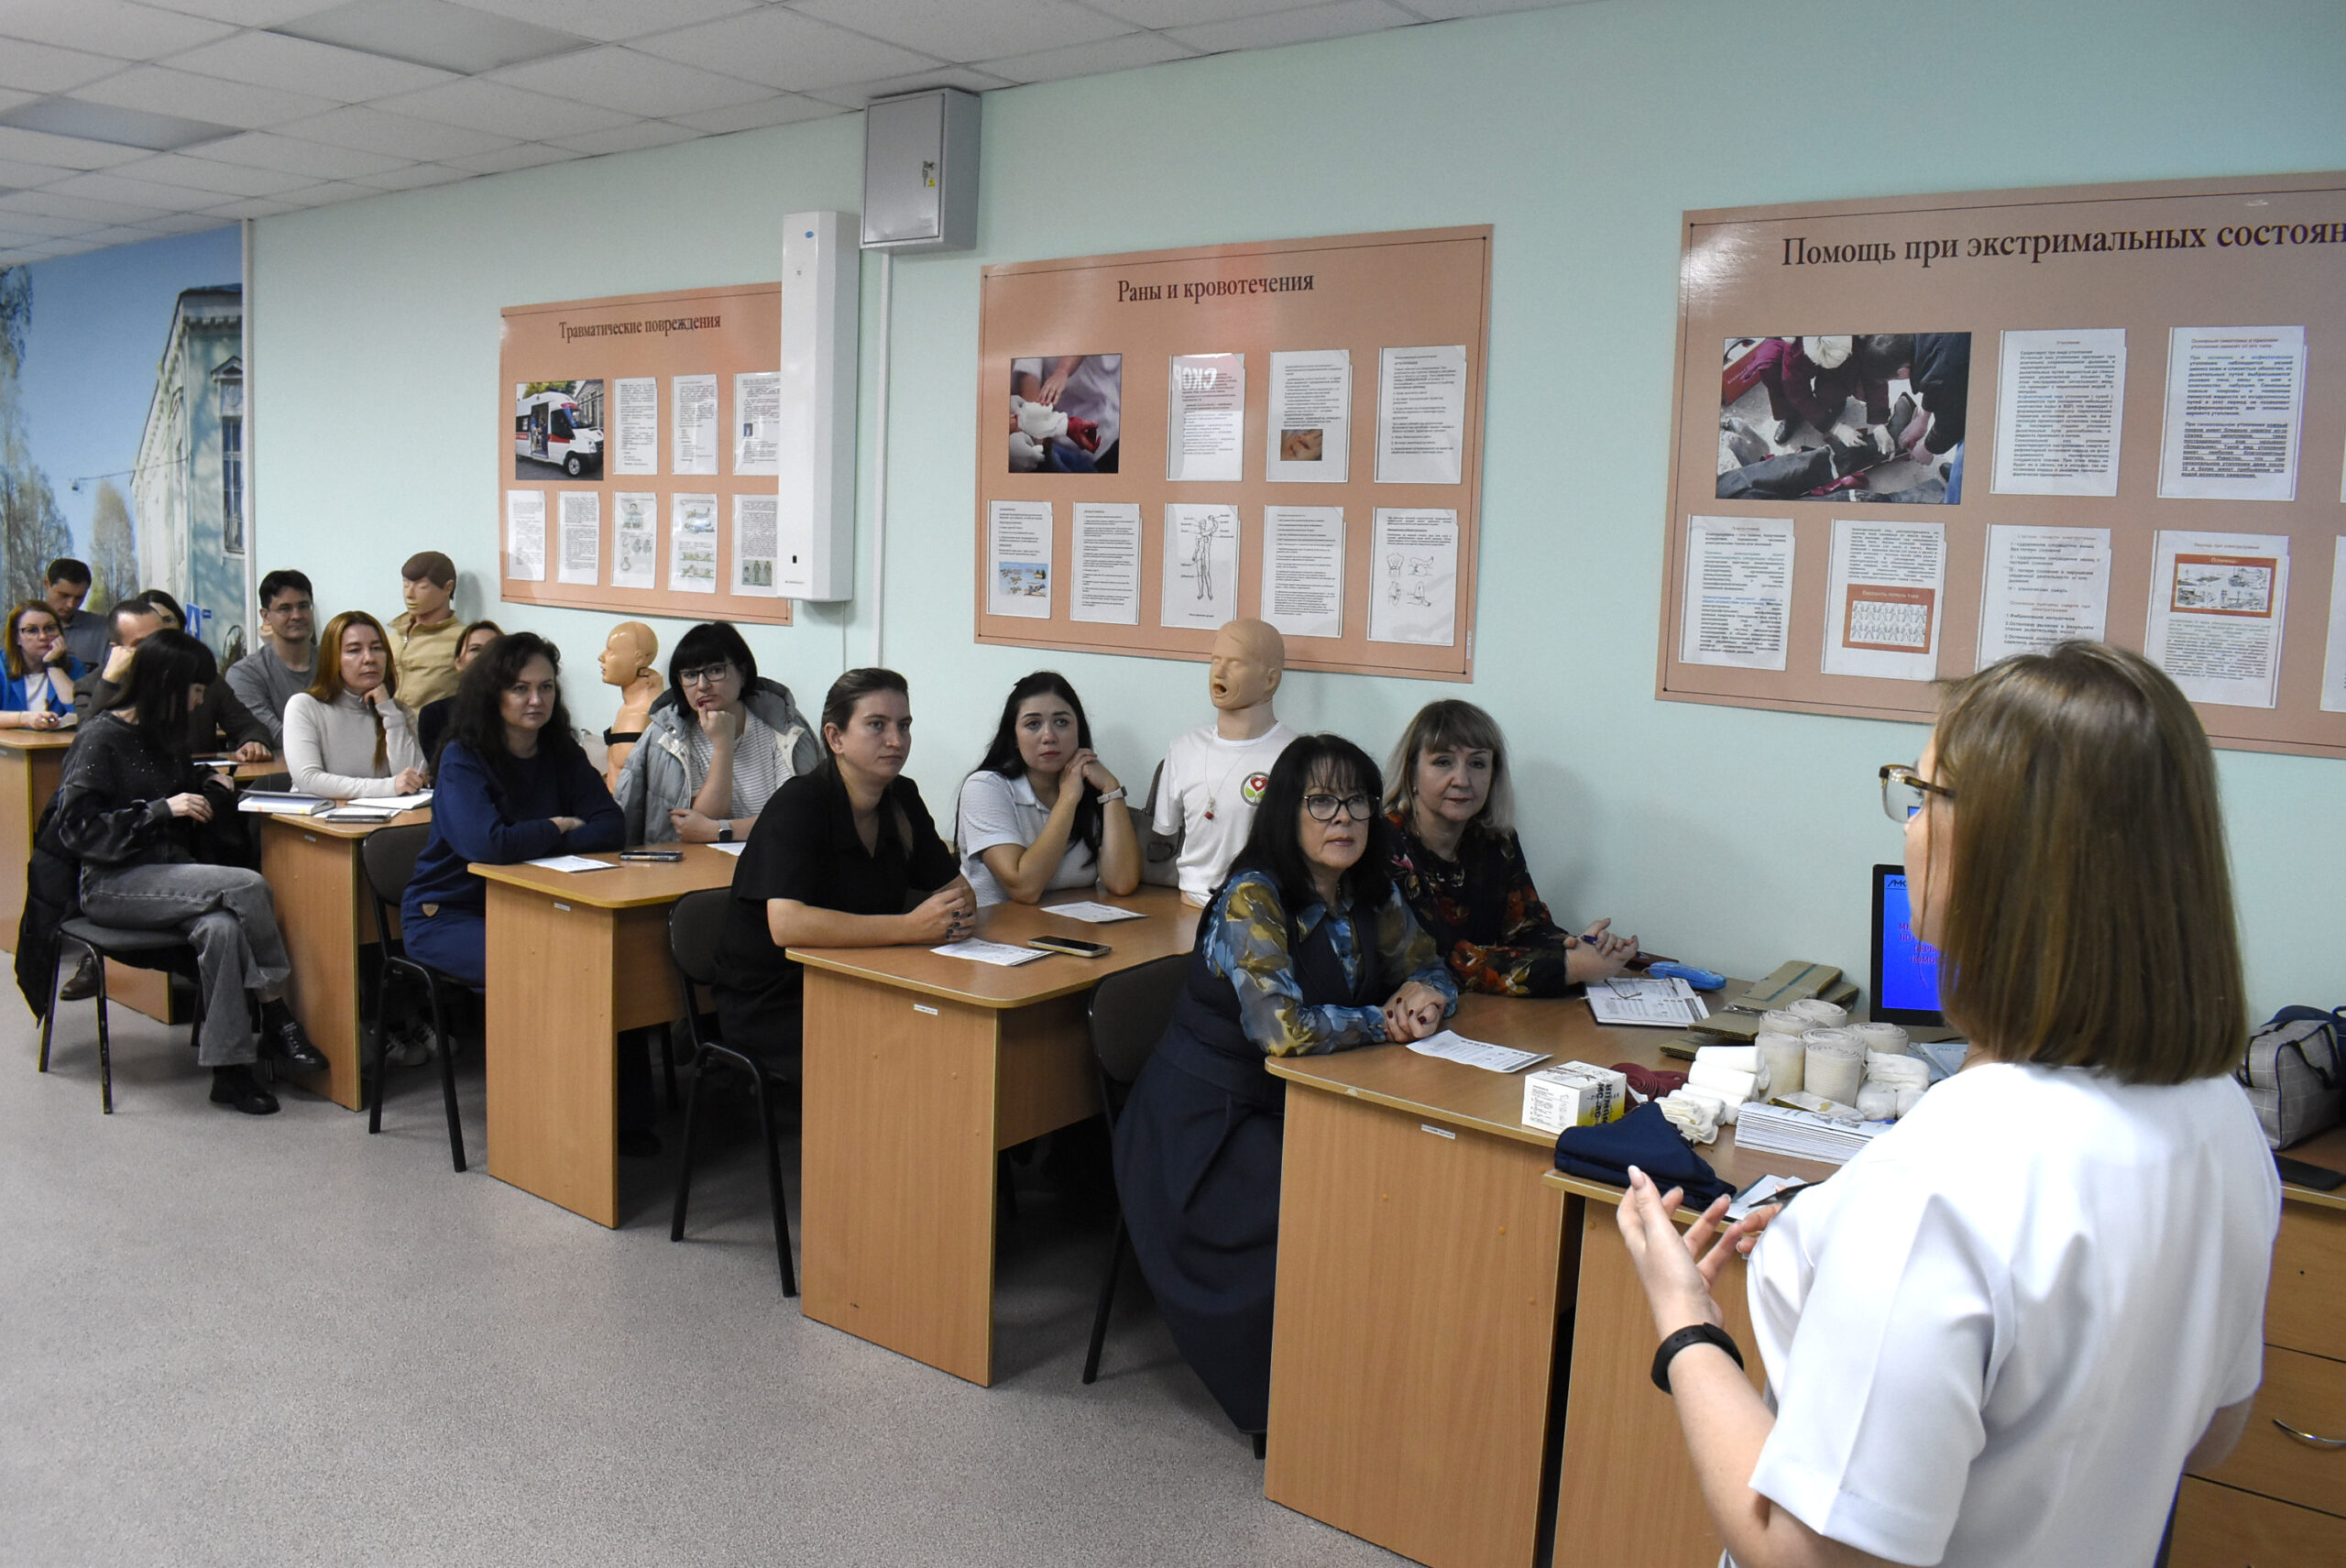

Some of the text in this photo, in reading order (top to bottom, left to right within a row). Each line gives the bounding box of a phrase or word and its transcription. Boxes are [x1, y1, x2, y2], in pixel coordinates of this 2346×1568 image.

[1781, 237, 1896, 265] Помощь
[1904, 239, 1959, 269] при
[1967, 227, 2207, 264] экстримальных
[1117, 275, 1314, 304] Раны и кровотечения
[559, 315, 721, 344] Травматические повреждения
